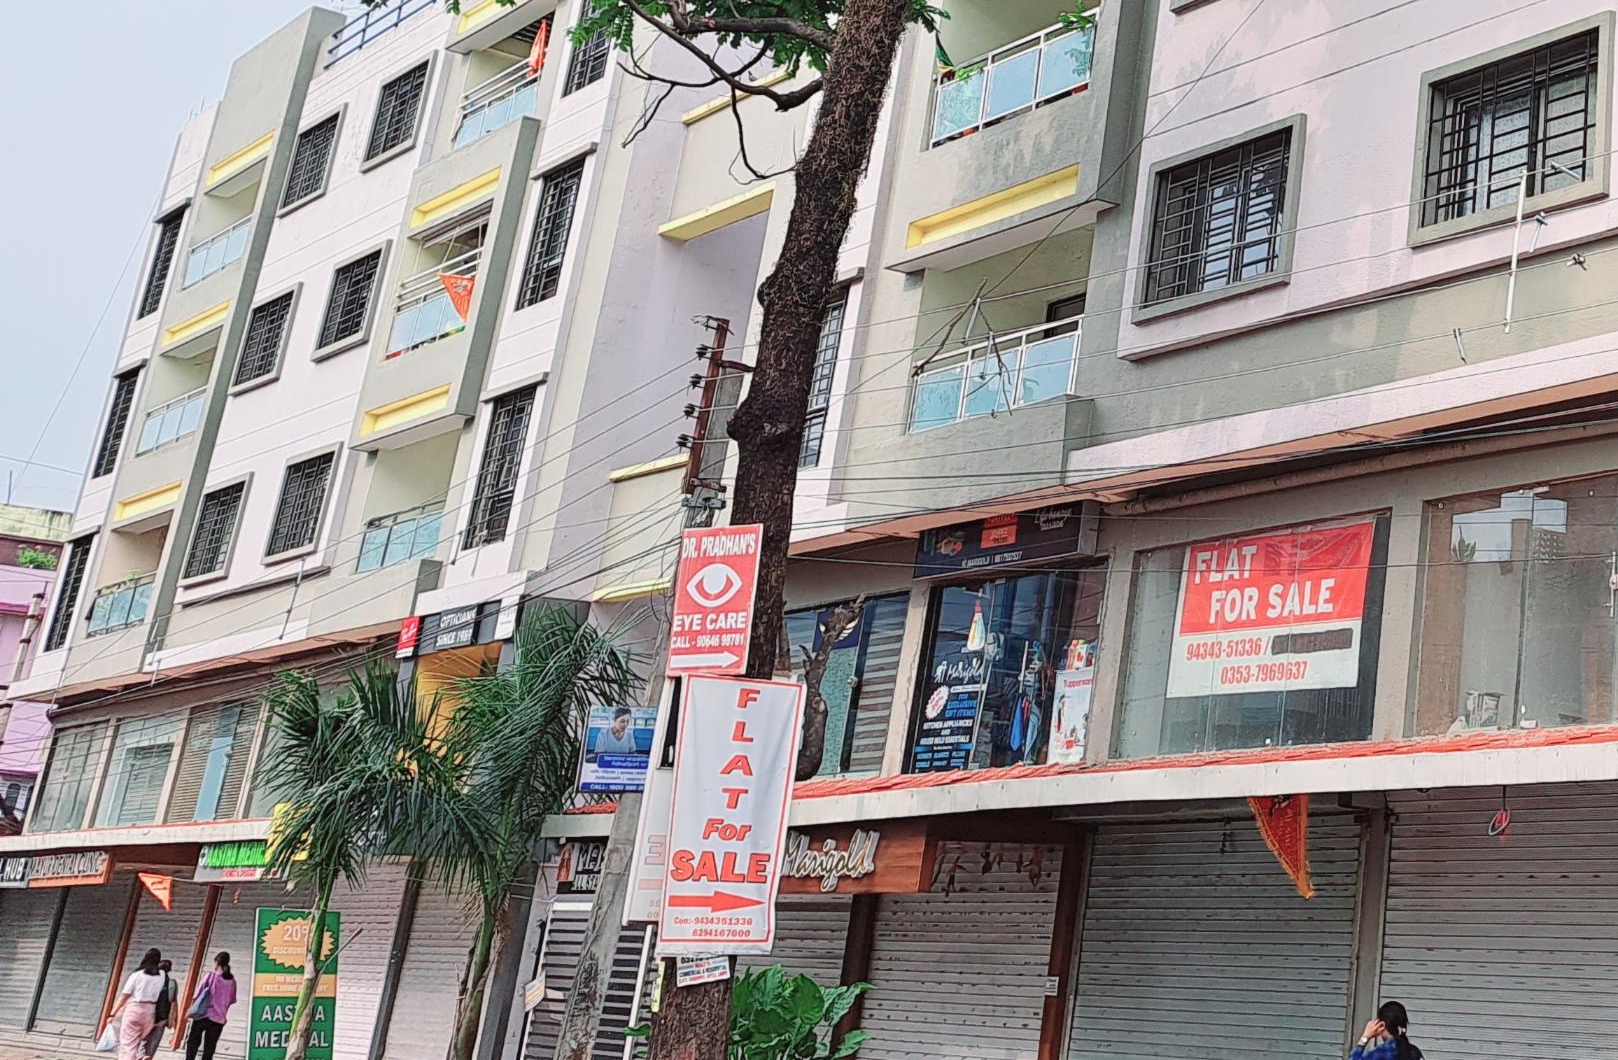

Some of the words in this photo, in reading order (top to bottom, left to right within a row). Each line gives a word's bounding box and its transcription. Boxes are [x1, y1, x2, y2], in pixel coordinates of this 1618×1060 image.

[682, 538, 698, 559] DR.
[700, 533, 756, 557] PRADHAN'S
[1194, 545, 1258, 584] FLAT
[1208, 586, 1259, 624] FOR
[1265, 578, 1336, 619] SALE
[673, 613, 702, 632] EYE
[705, 611, 747, 630] CARE
[436, 632, 456, 647] SINCE
[671, 635, 690, 648] CALL
[1186, 636, 1263, 661] 94343-51336
[1220, 661, 1308, 685] 0353-7969637
[702, 818, 752, 841] For
[3, 857, 26, 881] HUB
[670, 849, 771, 884] SALE
[783, 828, 878, 892] Marigold
[261, 1004, 326, 1023] AASA
[255, 1030, 329, 1049] MEDAL
